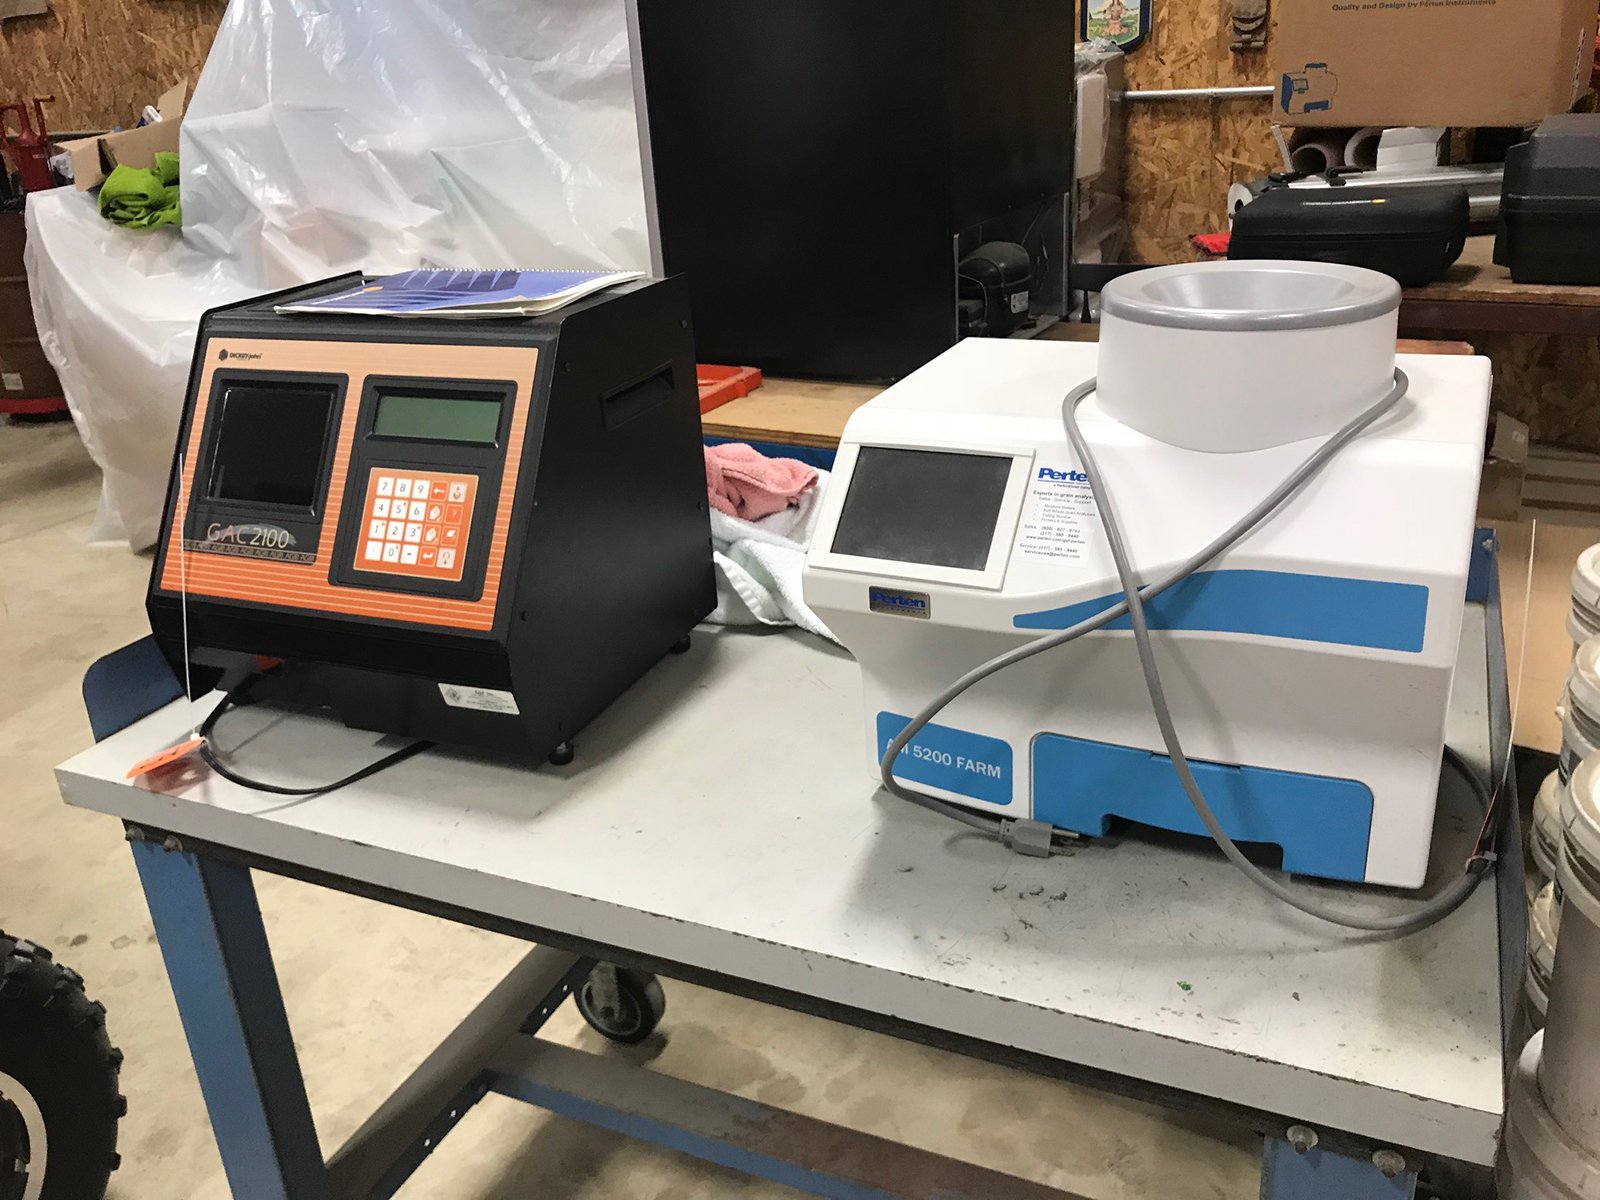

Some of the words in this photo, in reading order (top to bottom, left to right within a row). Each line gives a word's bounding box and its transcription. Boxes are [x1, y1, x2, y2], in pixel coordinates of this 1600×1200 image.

[1332, 3, 1359, 11] Quality
[1362, 2, 1377, 10] and
[1379, 1, 1406, 10] Design
[1038, 468, 1088, 481] Perte
[383, 482, 388, 490] 7
[400, 483, 406, 492] 8
[418, 485, 424, 493] 9
[379, 503, 384, 512] 4
[396, 505, 402, 514] 5
[414, 506, 420, 515] 6
[207, 522, 250, 544] GAC
[250, 527, 290, 549] 2100
[392, 526, 398, 535] 2
[410, 528, 416, 537] 3
[388, 548, 394, 557] 0
[872, 591, 926, 608] Perten
[913, 745, 951, 766] 5200
[956, 756, 1001, 779] FARM
